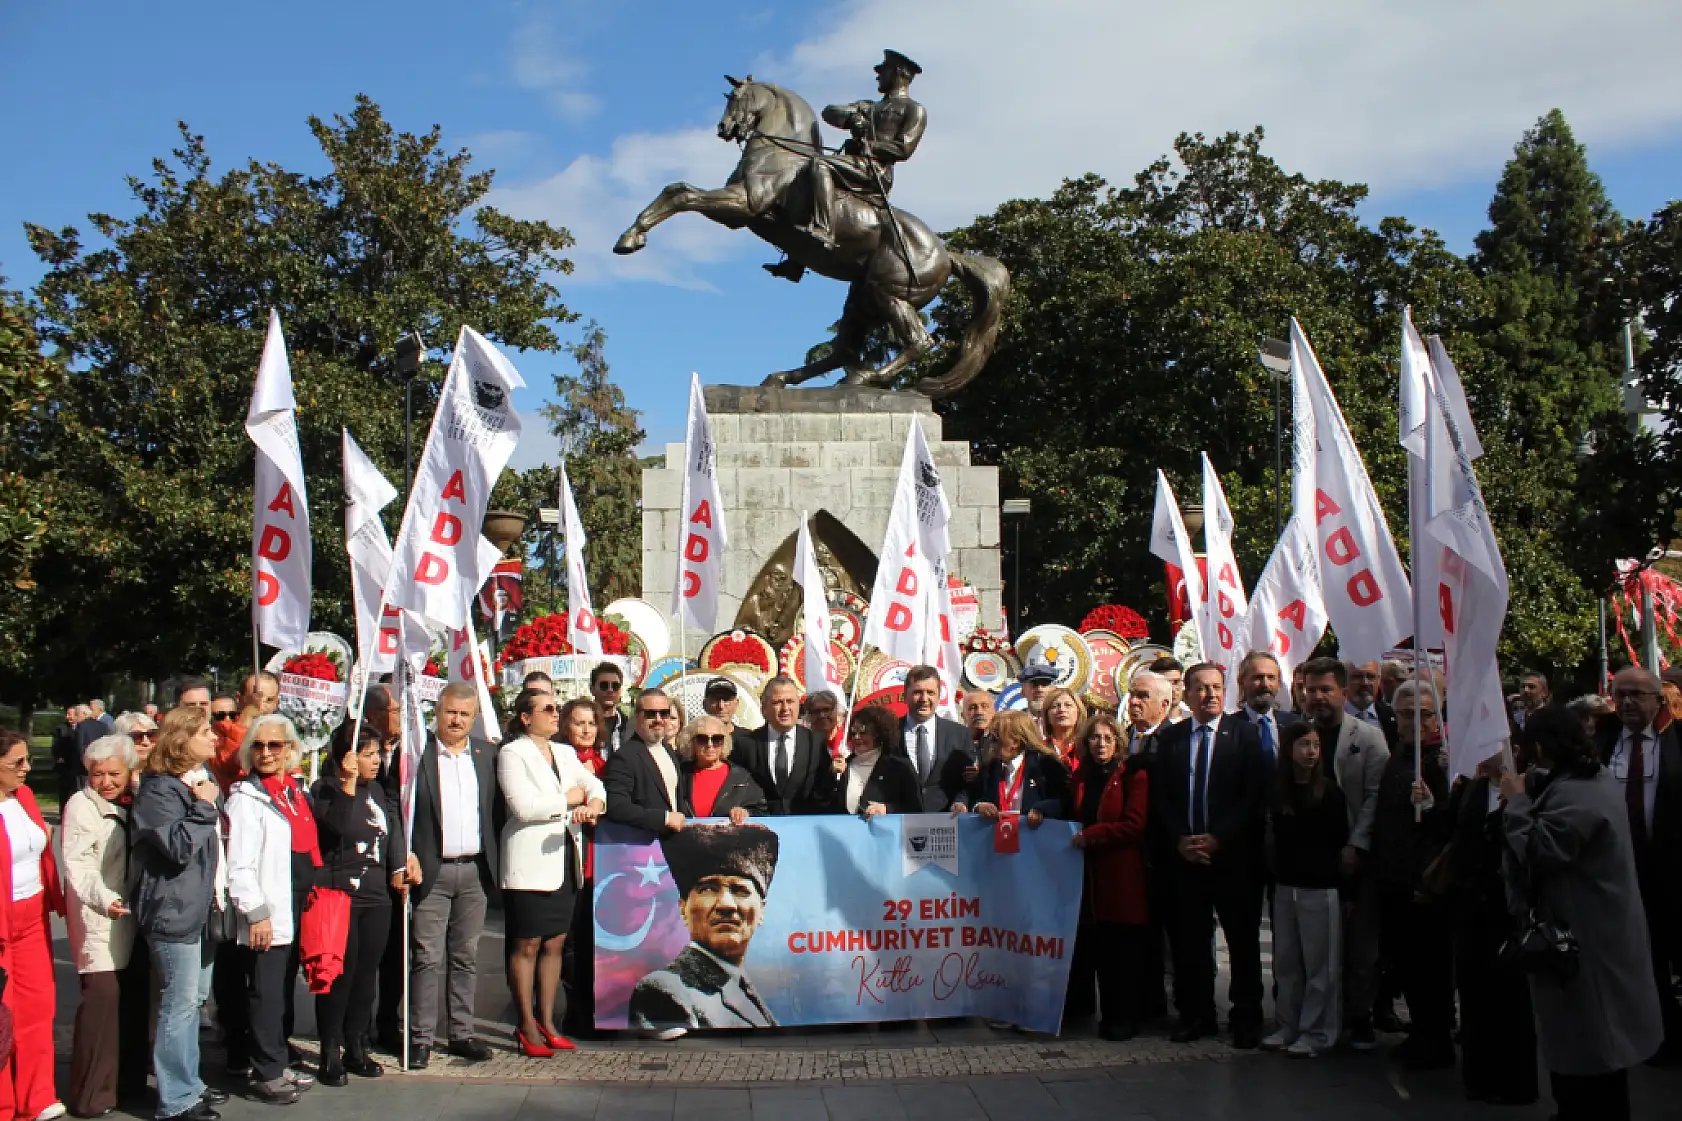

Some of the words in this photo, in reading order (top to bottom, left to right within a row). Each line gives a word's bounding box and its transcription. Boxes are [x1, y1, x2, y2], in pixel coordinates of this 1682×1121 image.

[410, 469, 466, 586] ADD
[1216, 562, 1237, 651] ADD
[883, 899, 913, 921] 29
[919, 891, 981, 920] EKİM
[787, 922, 955, 954] CUMHURİYET
[960, 926, 1066, 960] BAYRAMI
[850, 955, 924, 1005] Kutlu
[931, 951, 1007, 1001] Olsun
